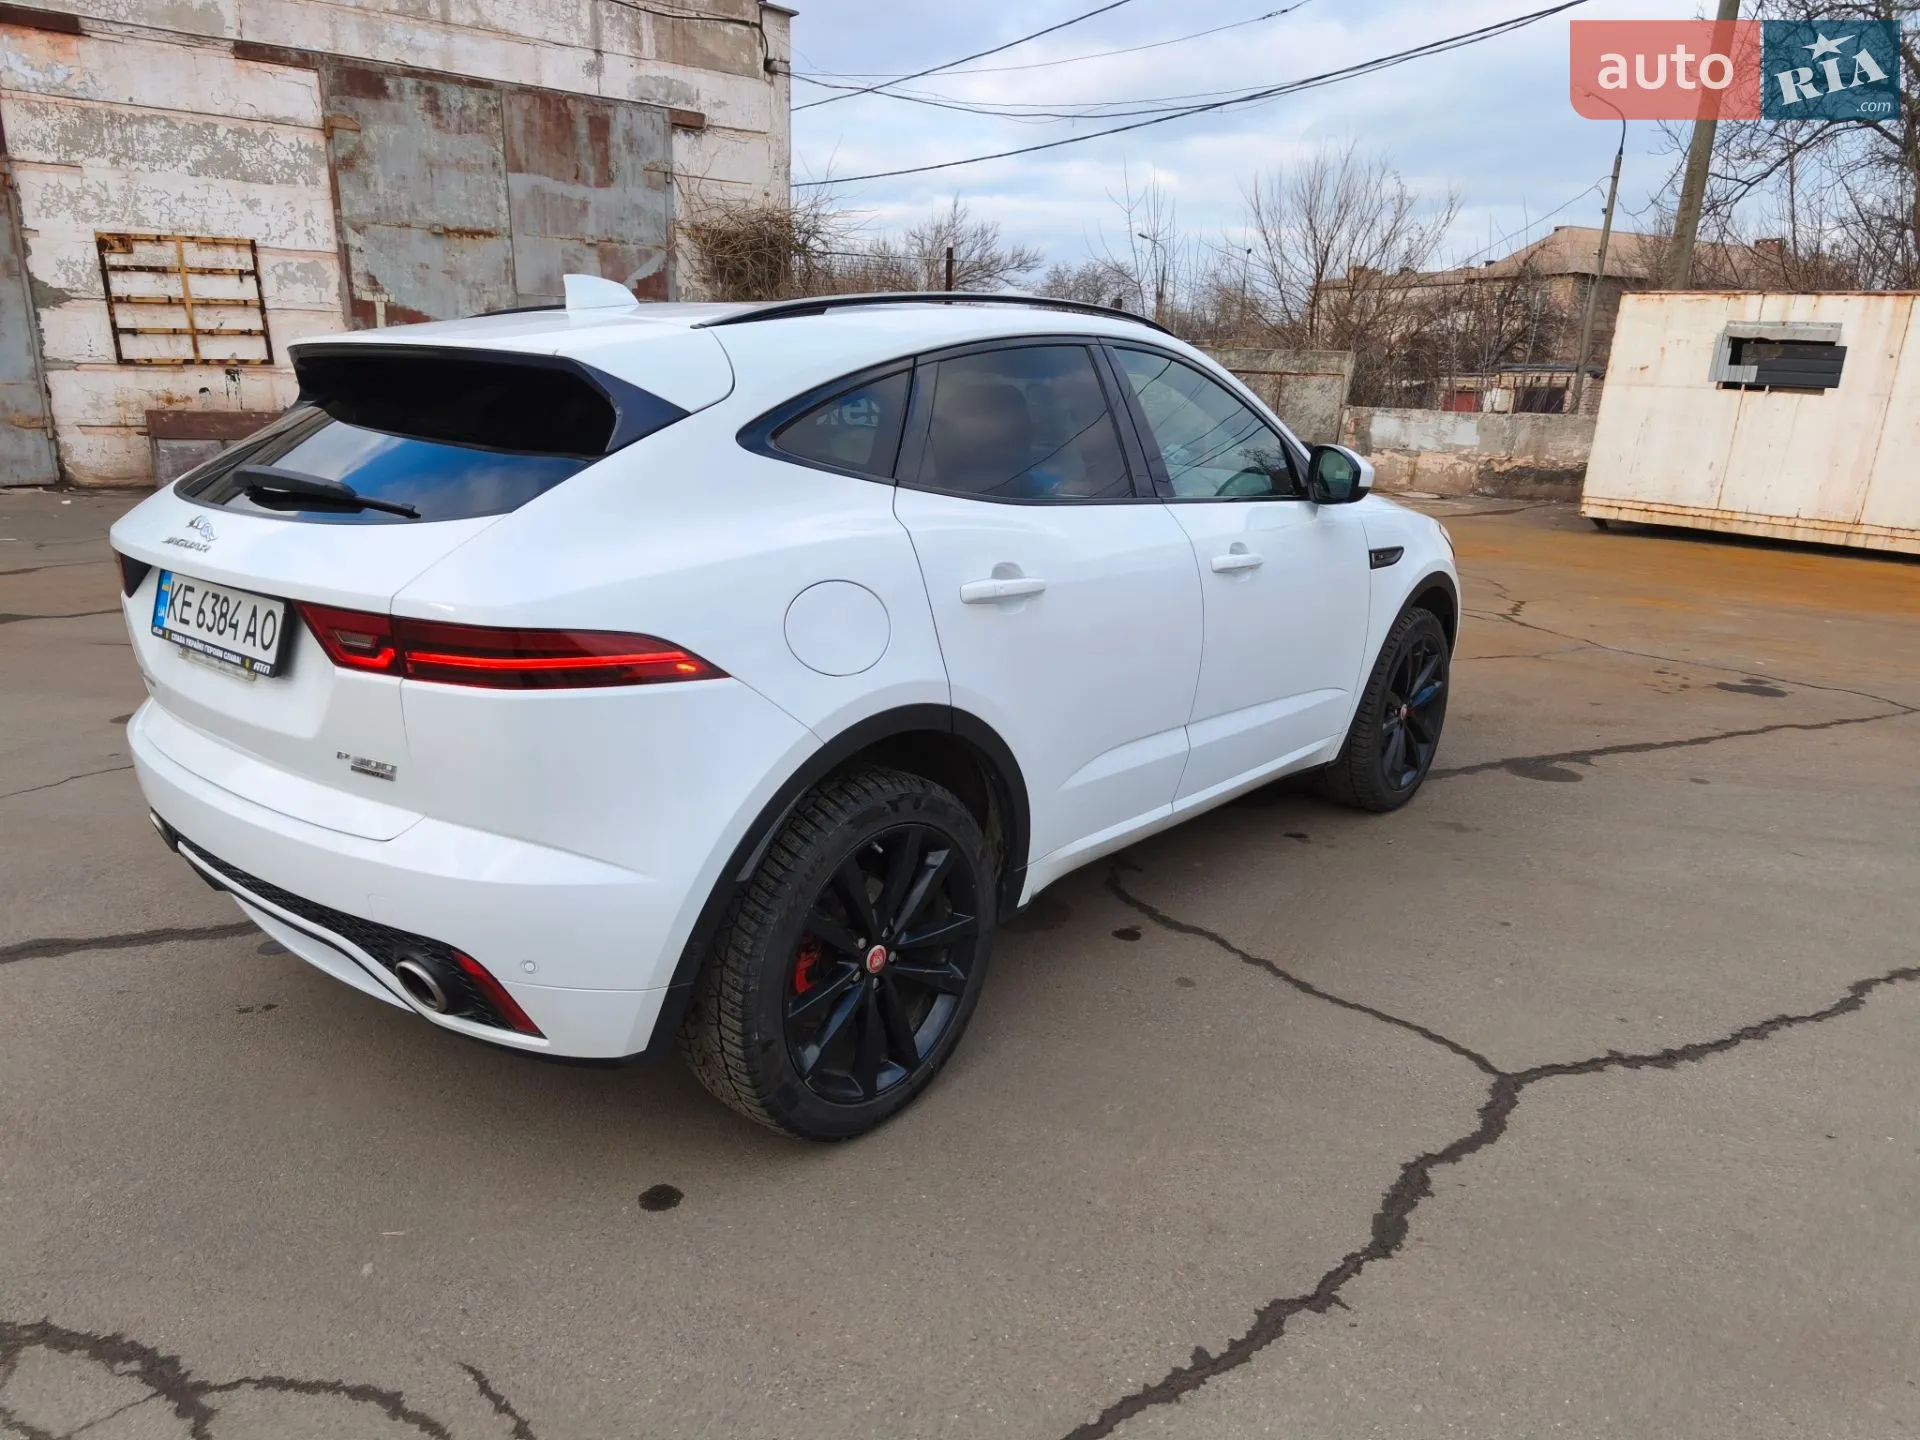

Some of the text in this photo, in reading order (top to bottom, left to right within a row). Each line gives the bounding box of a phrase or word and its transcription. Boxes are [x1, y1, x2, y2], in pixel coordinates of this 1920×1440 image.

[166, 580, 277, 651] KE 6384 AO
